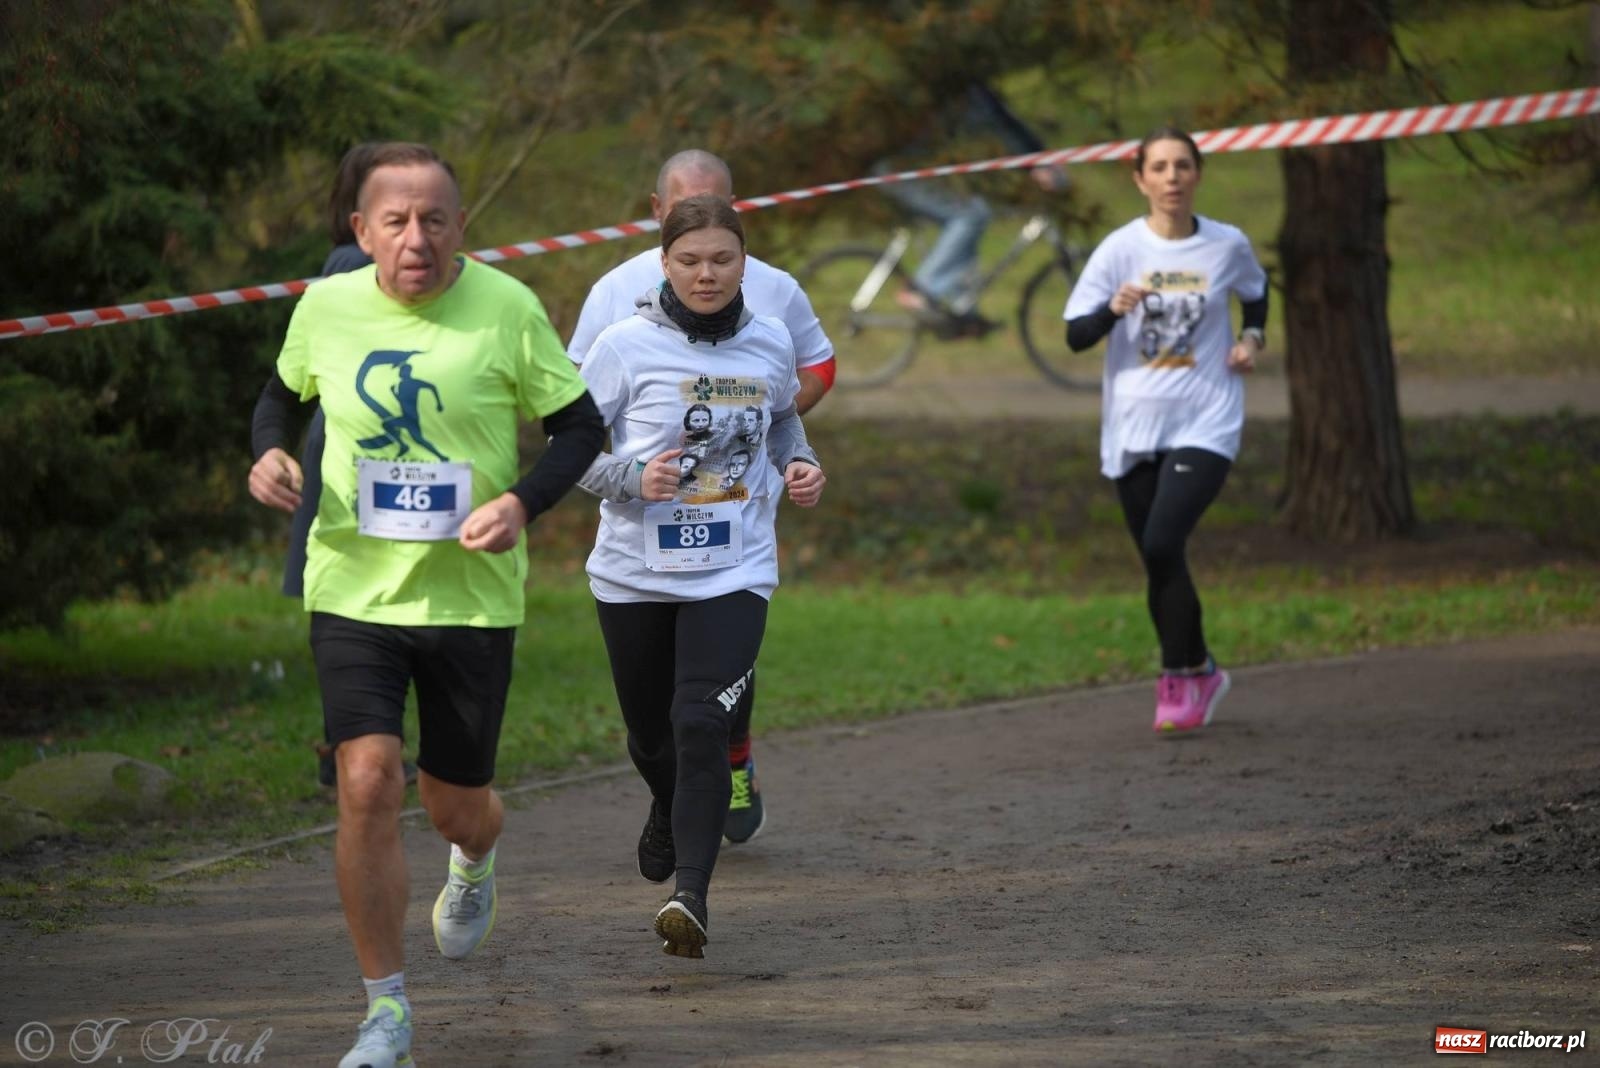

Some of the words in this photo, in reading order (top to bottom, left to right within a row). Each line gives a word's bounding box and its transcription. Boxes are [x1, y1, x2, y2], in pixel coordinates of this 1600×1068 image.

[716, 385, 757, 397] WILCZYM
[394, 485, 432, 511] 46
[729, 489, 745, 500] 2024
[686, 511, 714, 520] WILCZYM
[679, 524, 710, 547] 89
[717, 675, 747, 712] JUST
